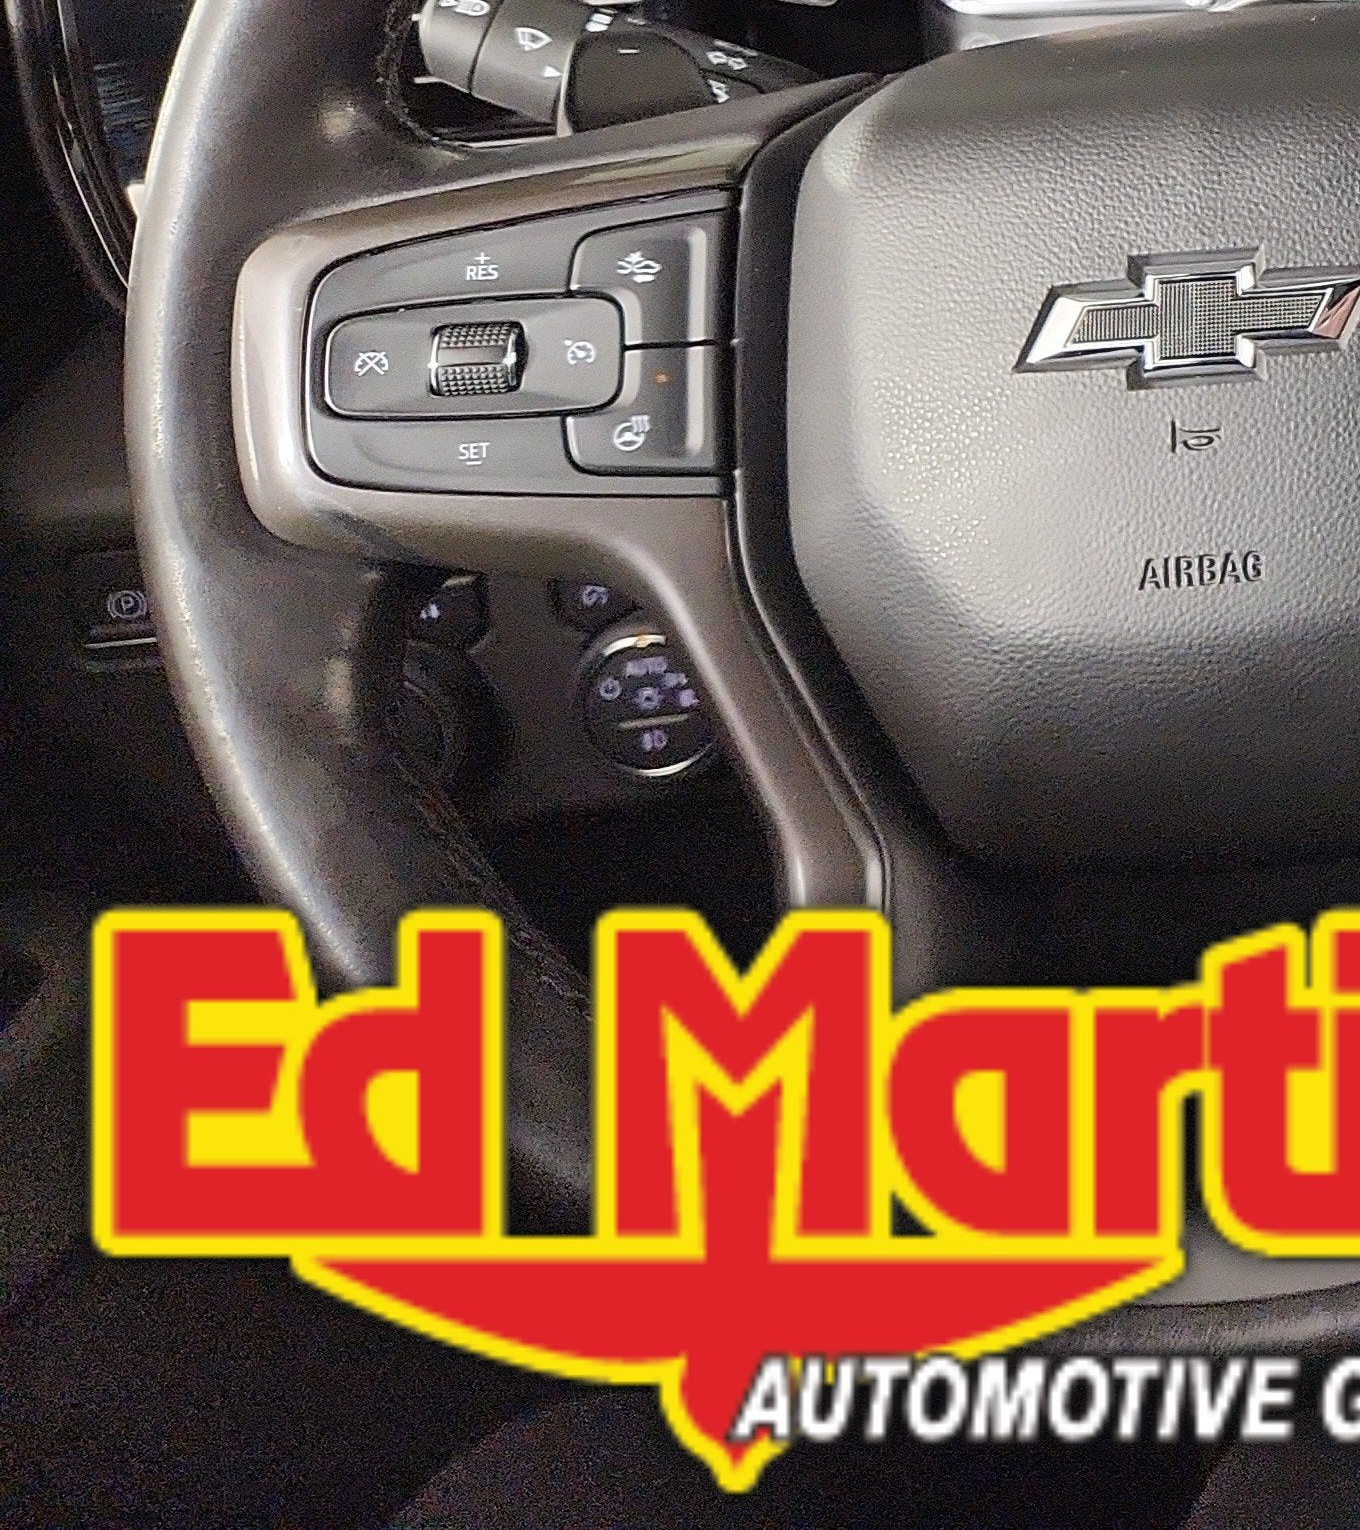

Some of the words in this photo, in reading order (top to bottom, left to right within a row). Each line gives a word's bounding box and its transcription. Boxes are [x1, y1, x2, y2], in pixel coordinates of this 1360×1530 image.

[466, 264, 499, 281] RES
[459, 442, 490, 460] SET
[1137, 550, 1265, 591] AIRBAG
